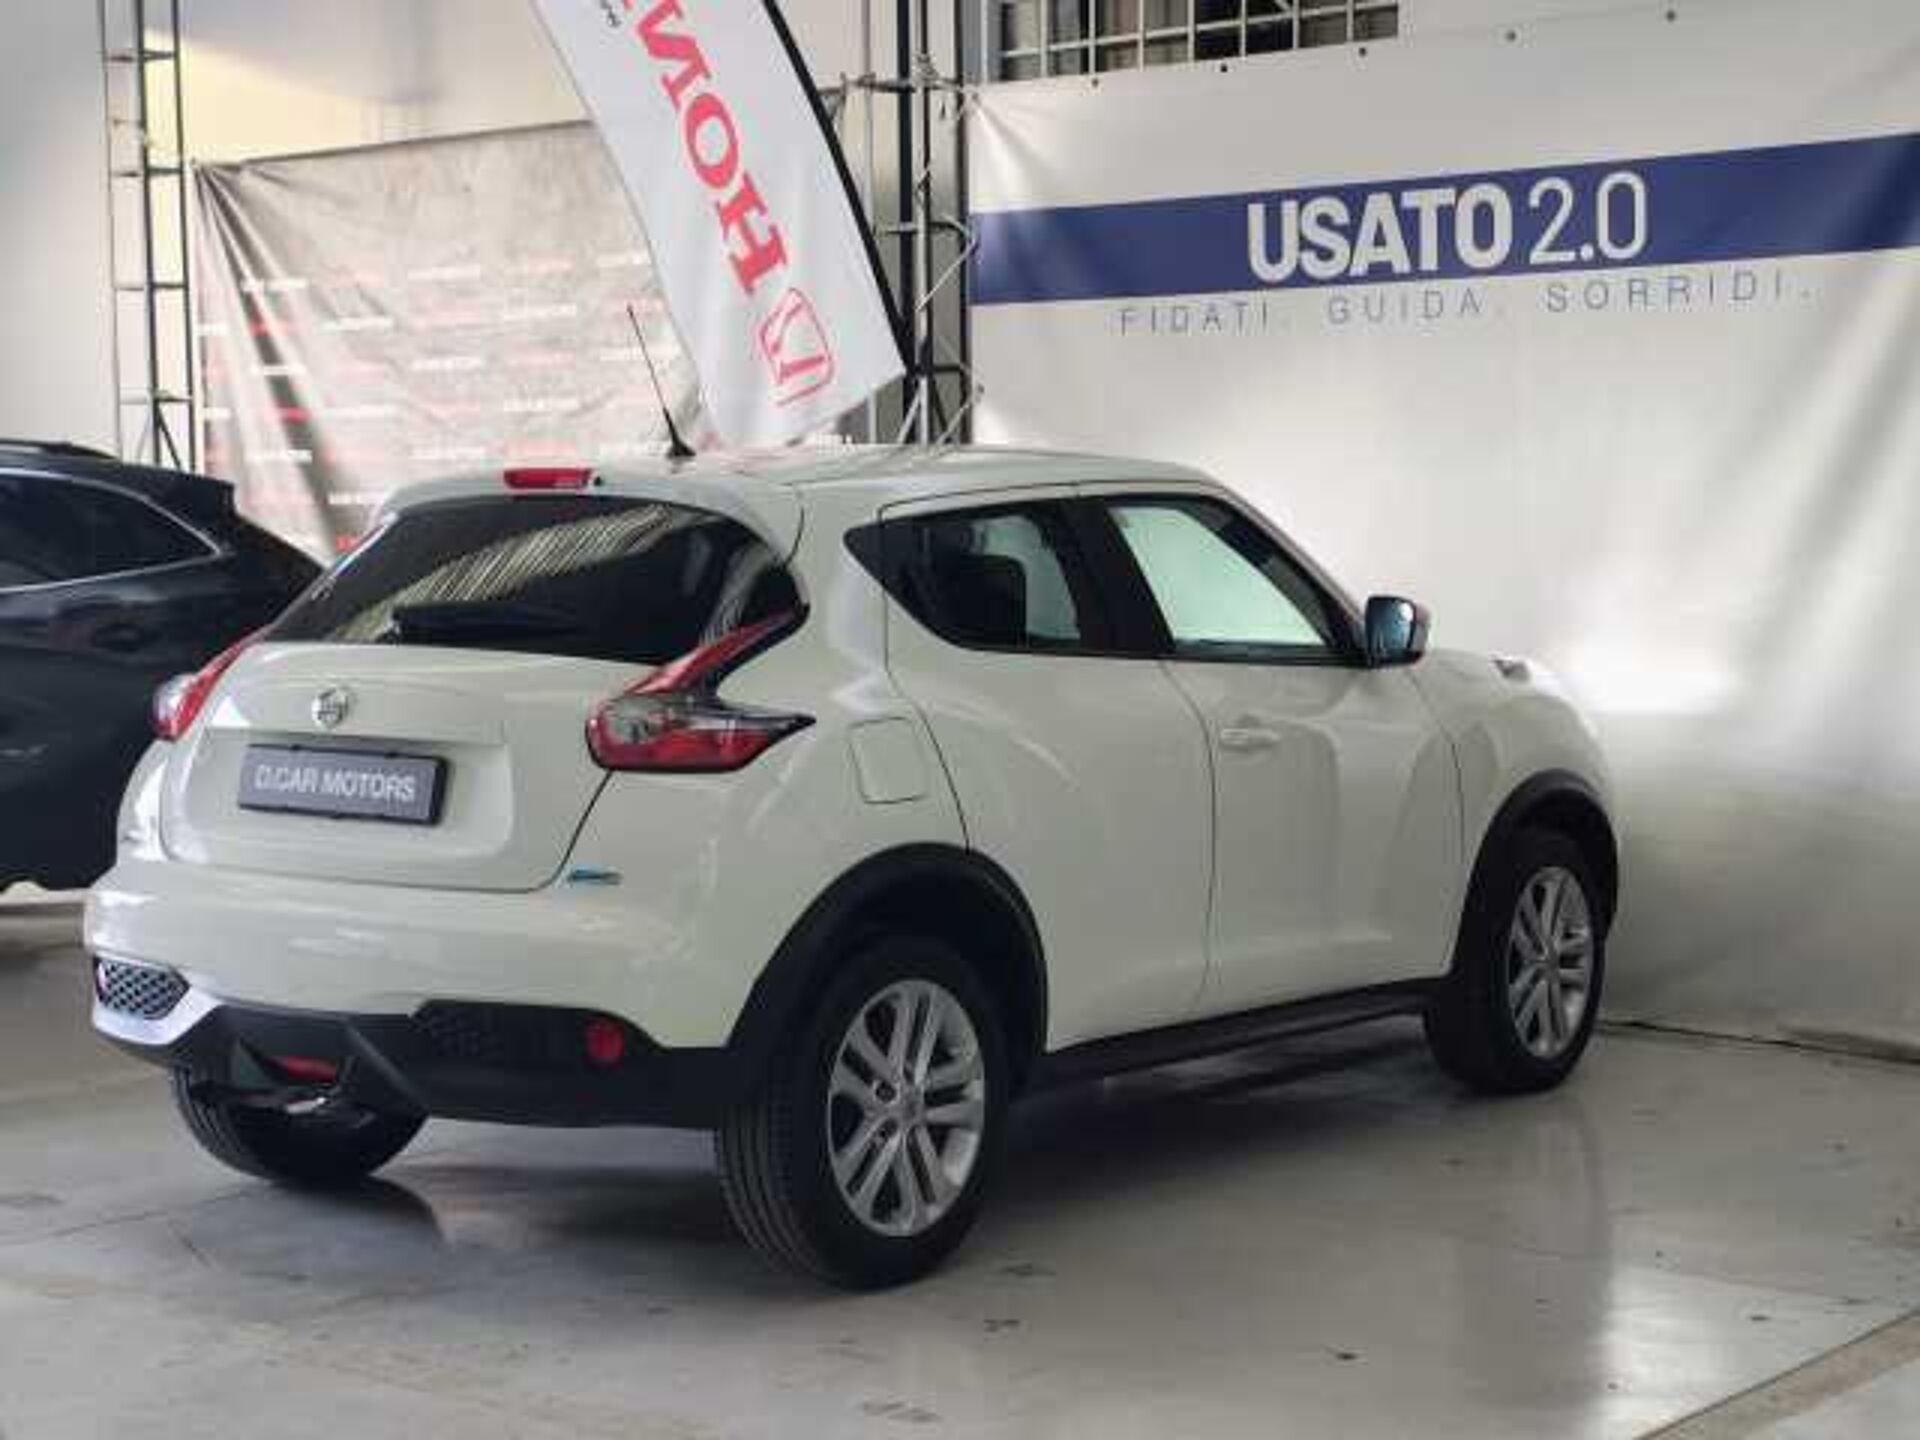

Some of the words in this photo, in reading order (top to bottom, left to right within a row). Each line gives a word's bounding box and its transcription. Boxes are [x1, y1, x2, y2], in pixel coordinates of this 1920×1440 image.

[1247, 182, 1512, 283] USATO
[1528, 170, 1648, 265] 2.0
[1546, 269, 1811, 313] SORRIDI.
[320, 770, 416, 803] MOTORS
